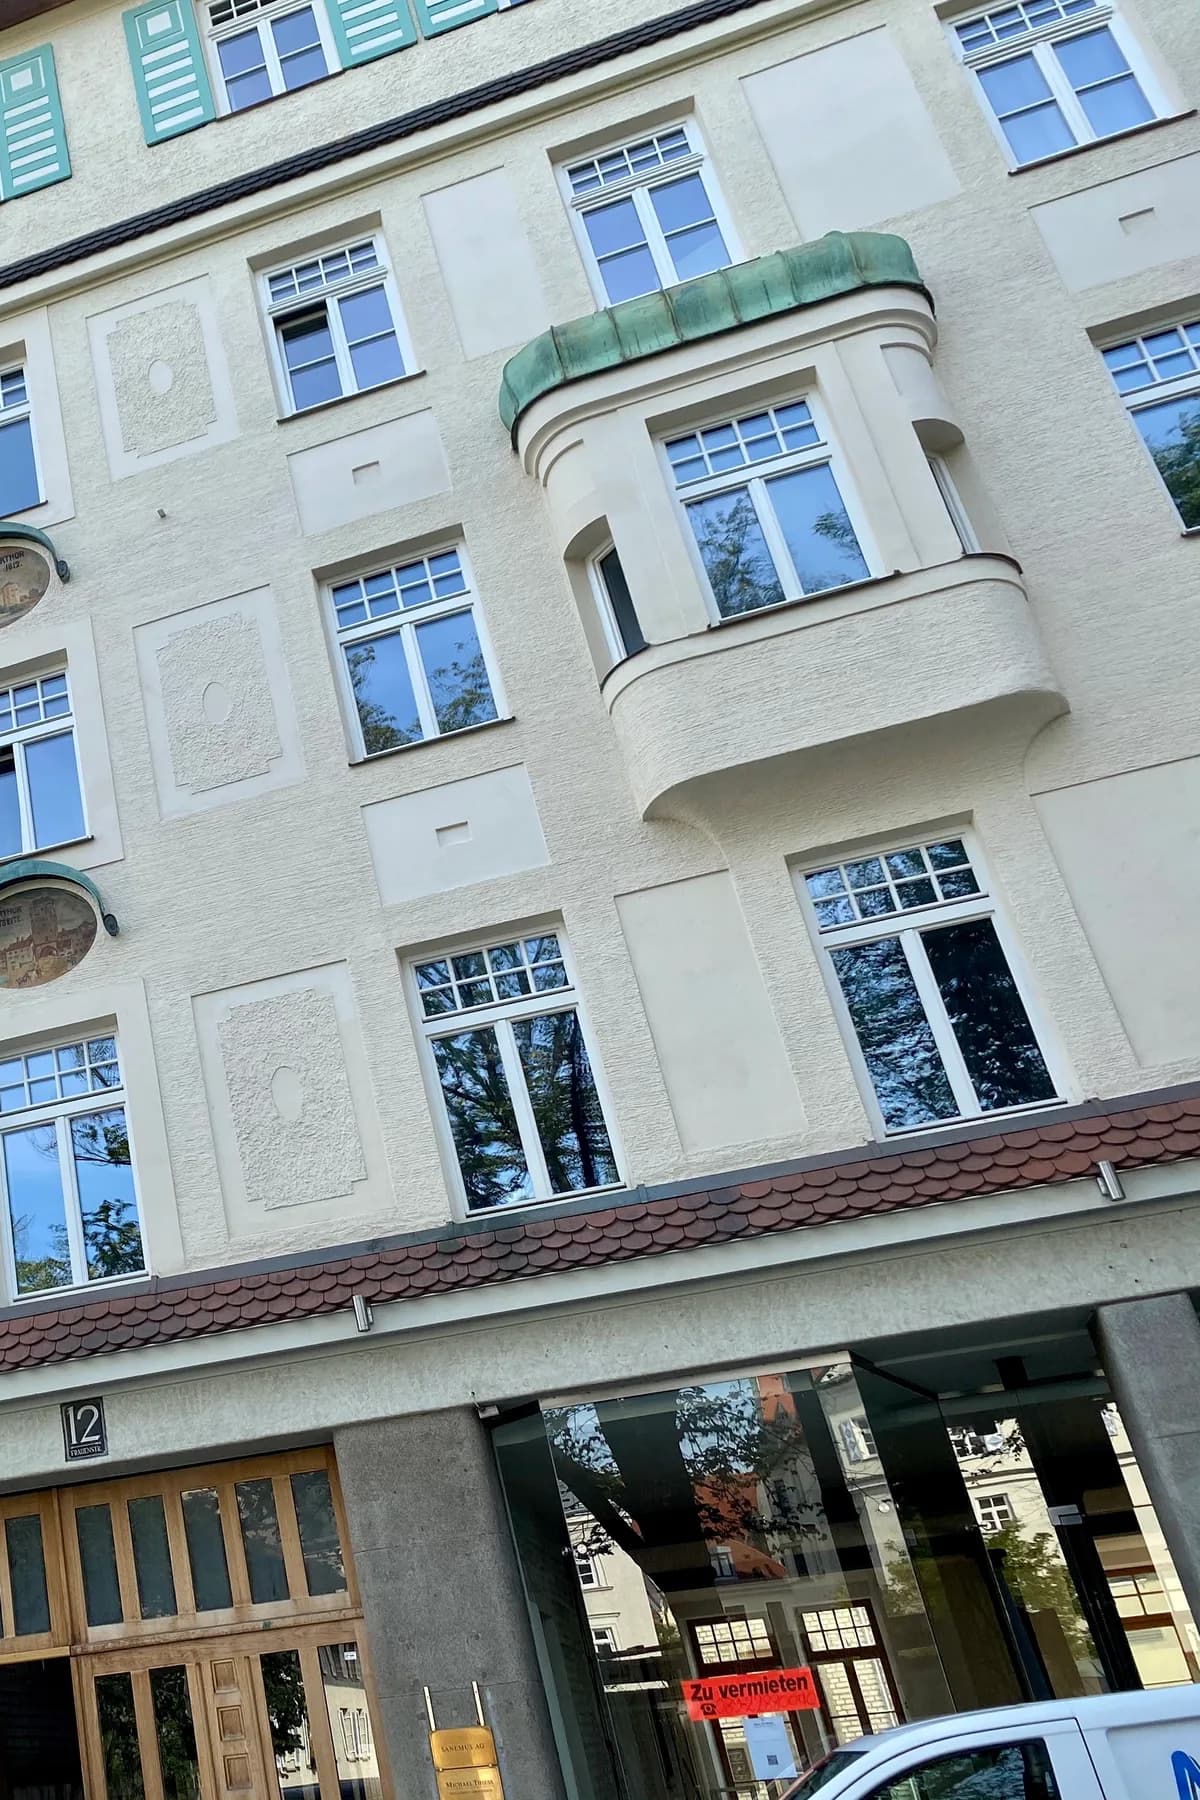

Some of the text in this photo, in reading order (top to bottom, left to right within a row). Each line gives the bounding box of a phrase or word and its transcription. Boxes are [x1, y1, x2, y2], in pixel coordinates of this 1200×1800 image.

[67, 1405, 99, 1444] 12
[690, 1675, 809, 1701] Zu vermieten
